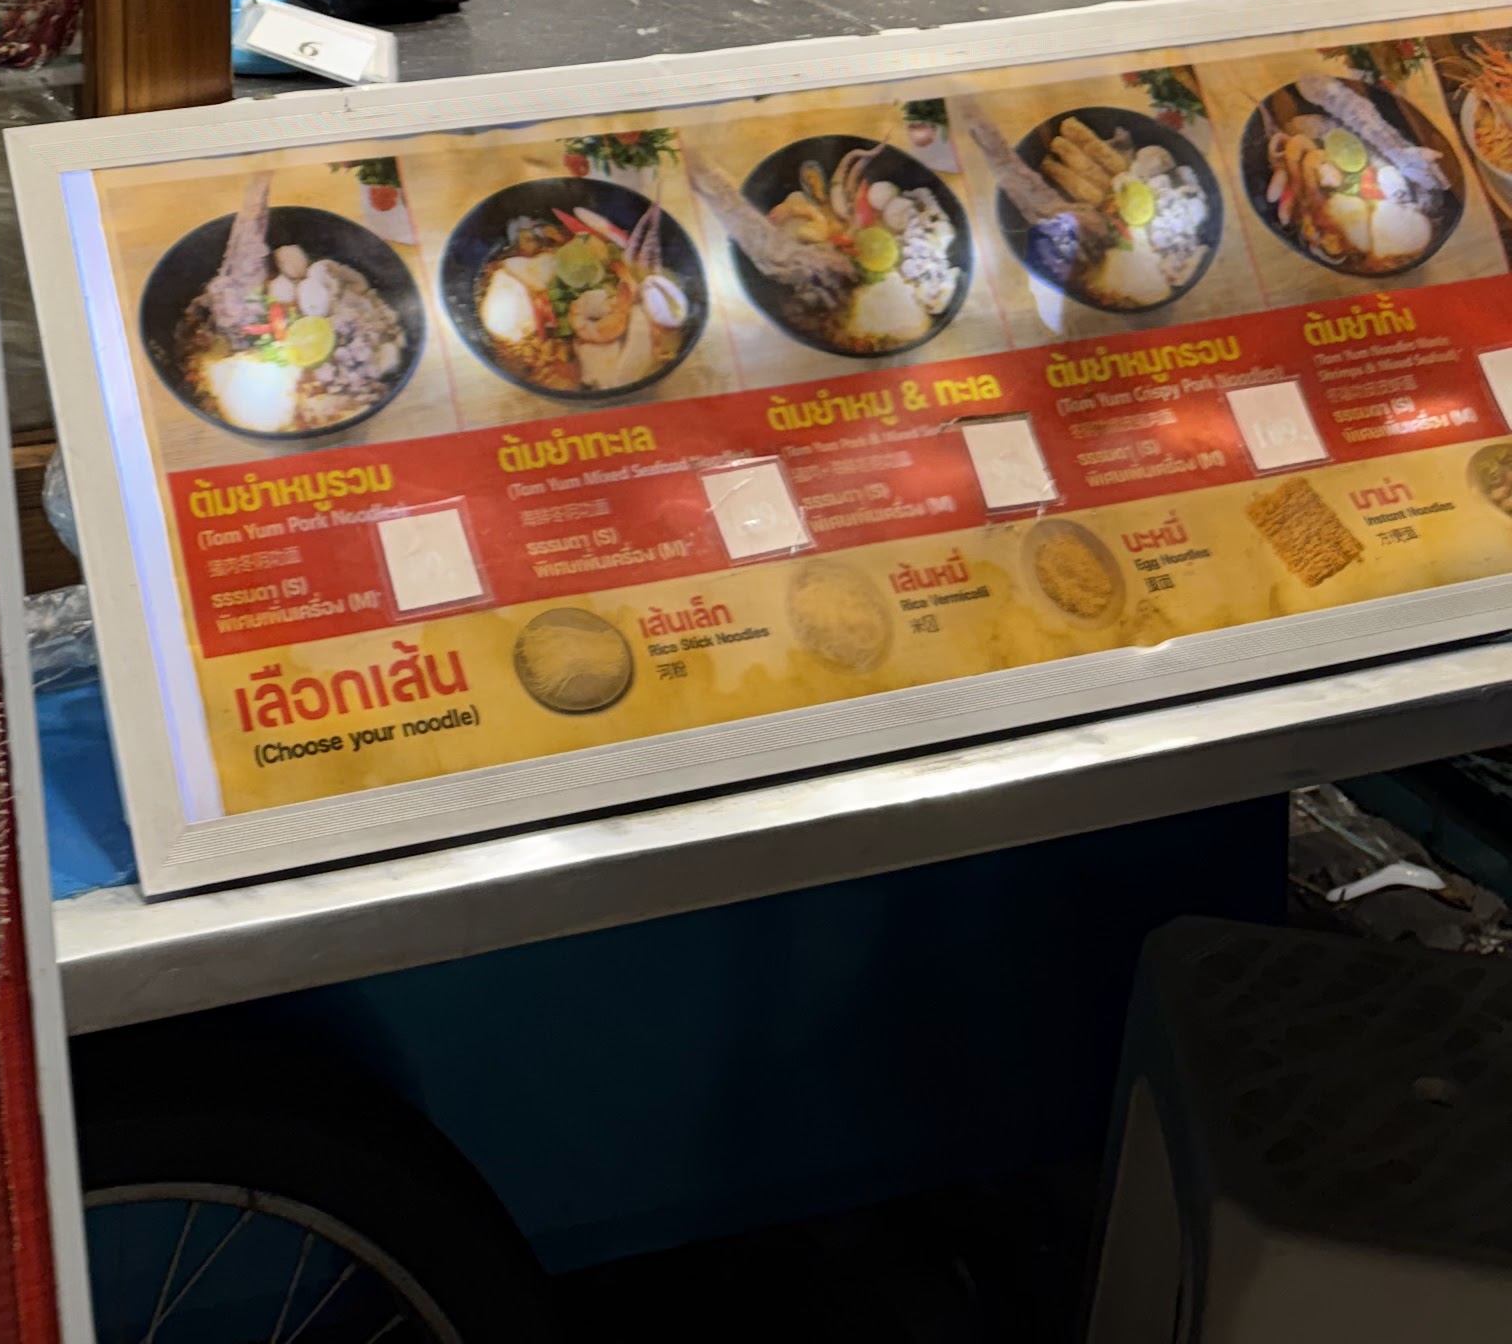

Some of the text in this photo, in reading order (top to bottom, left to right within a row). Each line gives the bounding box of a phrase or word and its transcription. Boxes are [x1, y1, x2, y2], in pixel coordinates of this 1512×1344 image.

[1046, 336, 1241, 388] ต้มยำหมูกรอบ
[767, 388, 896, 431] ต้มยำหมู
[900, 380, 929, 411] &
[934, 373, 1003, 407] ทะเล
[498, 425, 657, 472] ต้มยำทะเล
[190, 464, 395, 518] ต้มยำหมูรวม
[1349, 476, 1414, 511] มาม่า
[197, 527, 242, 551] (Tom
[243, 521, 285, 541] Yum
[288, 512, 329, 532] Pork
[1121, 509, 1190, 553] บะหมี่
[282, 576, 308, 597] (S)
[890, 547, 971, 594] เส้นหมี่
[1134, 556, 1159, 573] Egg
[638, 595, 734, 640] เส้นเล็ก
[899, 596, 929, 612] Rice
[648, 626, 771, 658] Rice Stick Noodles
[235, 640, 469, 733] เลือกเส้น
[254, 703, 481, 768] (Choose your noodle)
